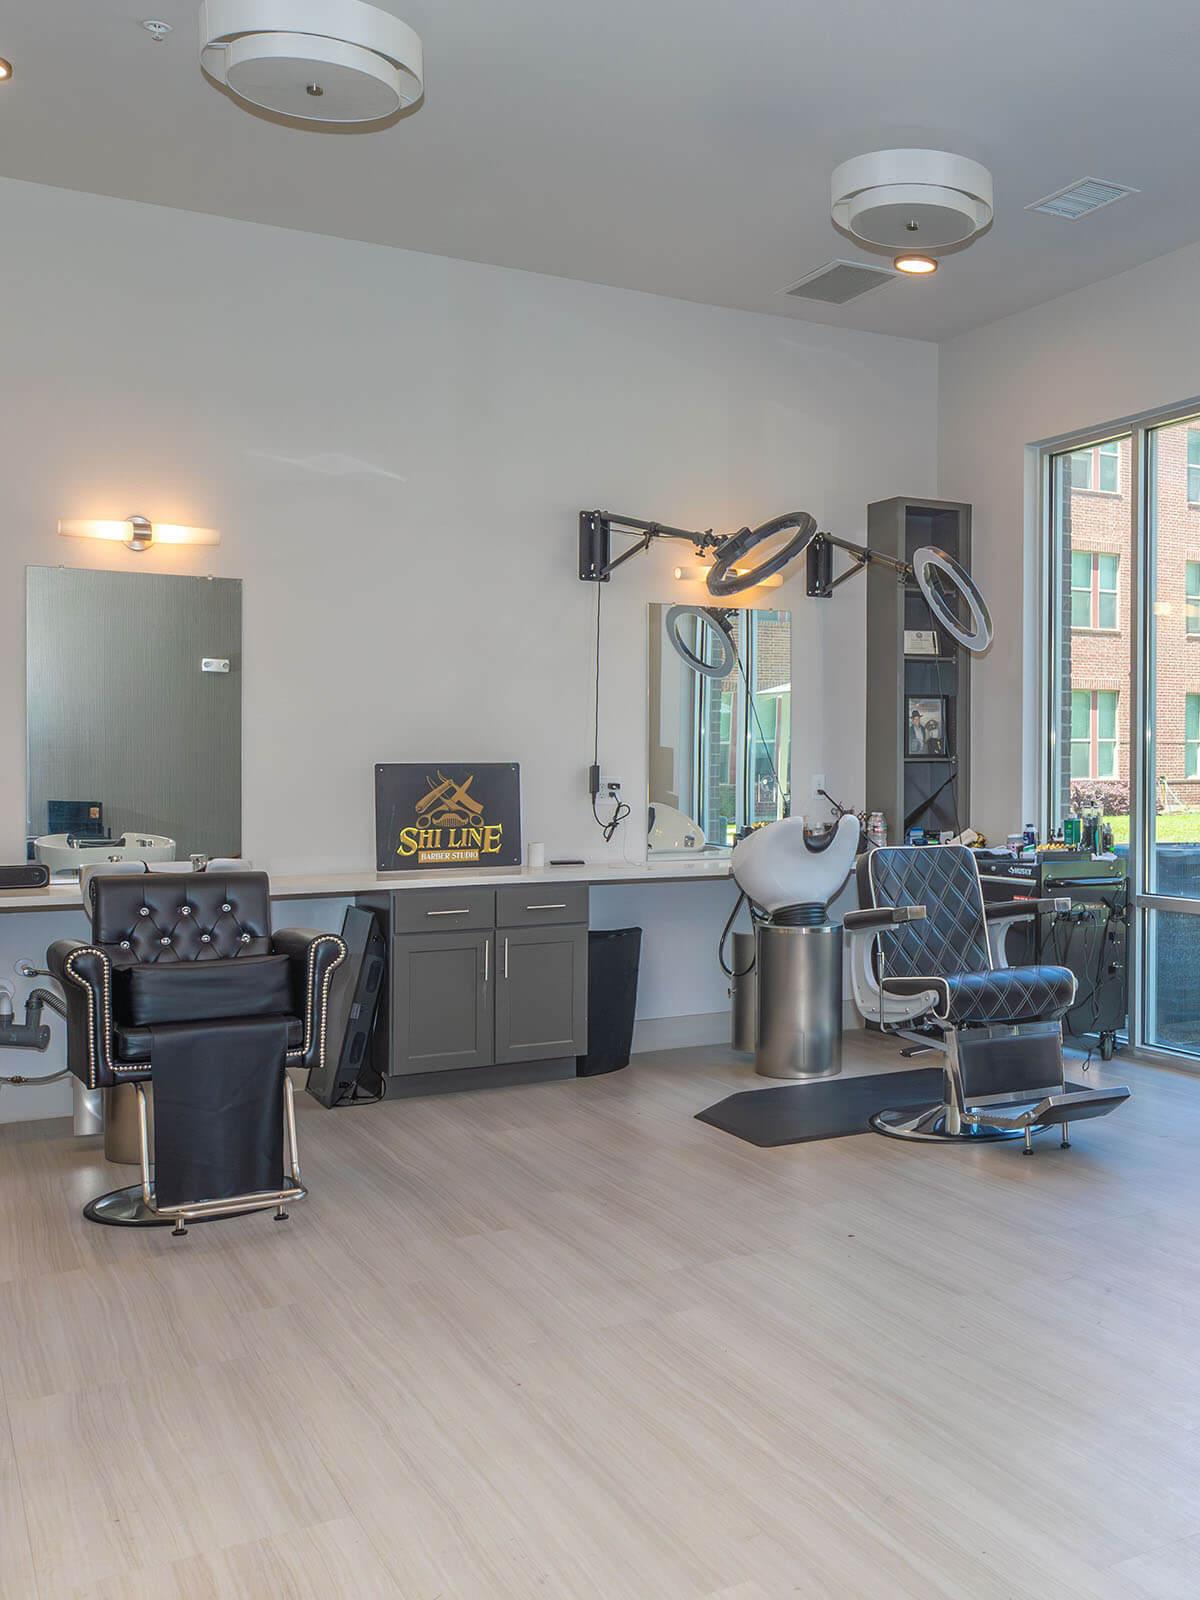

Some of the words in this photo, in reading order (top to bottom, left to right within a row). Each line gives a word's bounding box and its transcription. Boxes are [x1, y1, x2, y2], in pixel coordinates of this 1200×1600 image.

[397, 827, 442, 855] SHI
[448, 824, 502, 853] LINE
[421, 852, 450, 860] BARBER
[451, 851, 479, 859] STUDIO
